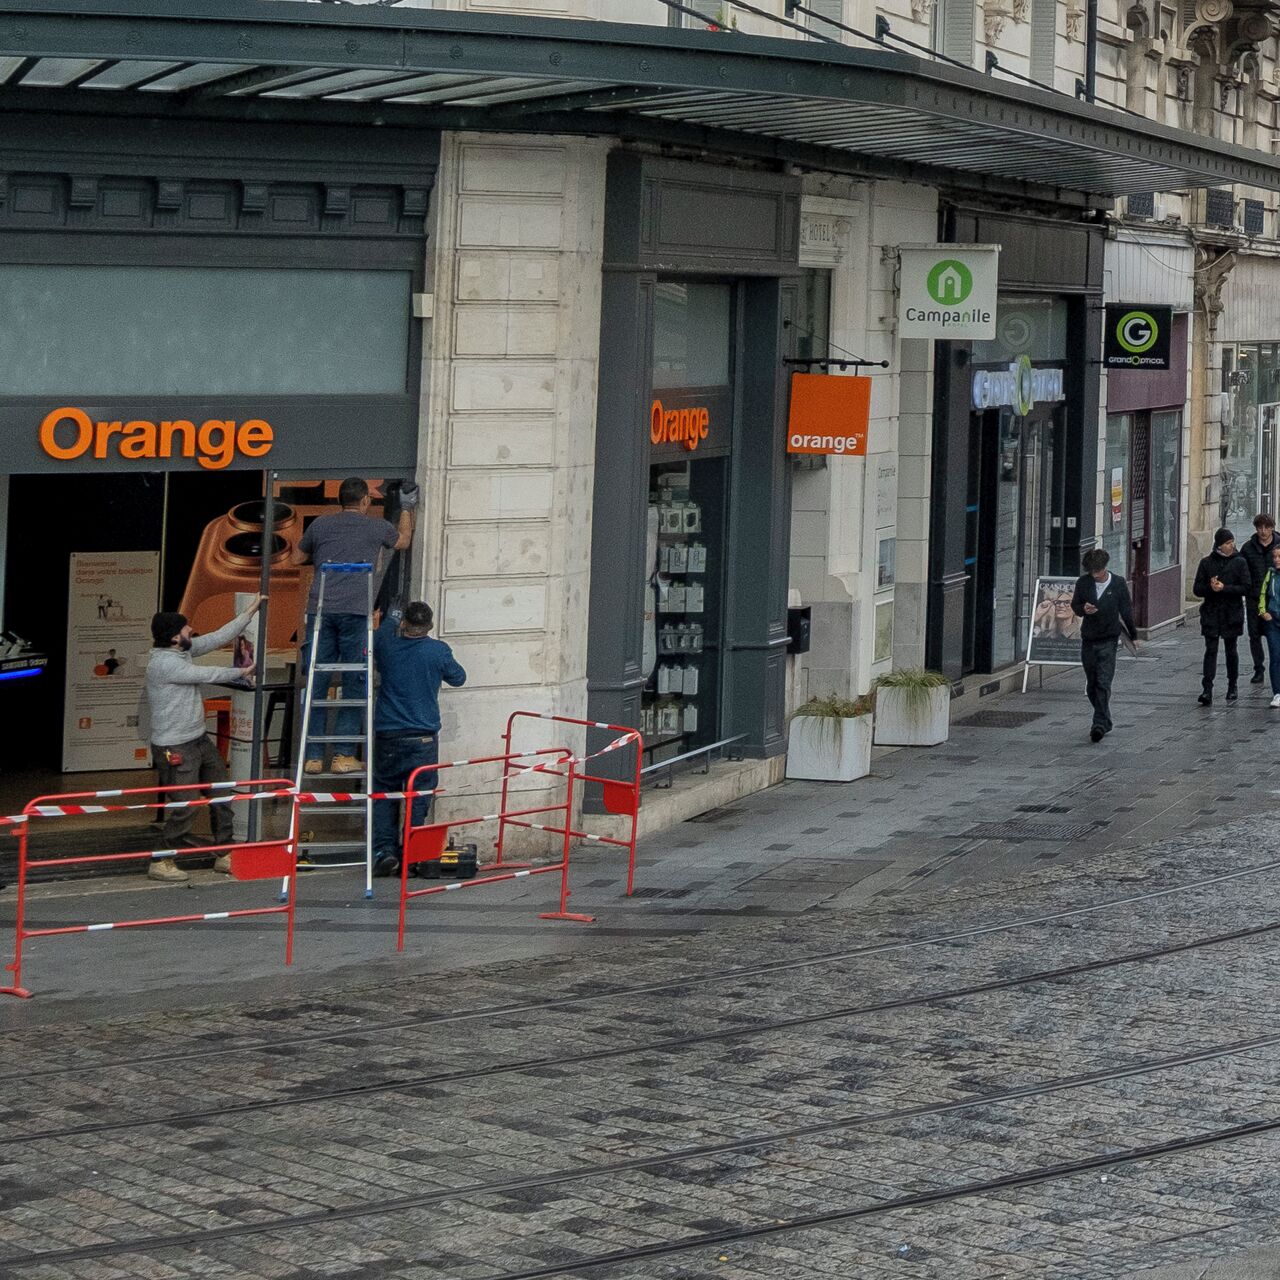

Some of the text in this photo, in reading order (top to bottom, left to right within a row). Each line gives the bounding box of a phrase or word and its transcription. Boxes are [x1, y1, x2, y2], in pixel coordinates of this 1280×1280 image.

[906, 308, 990, 326] Campanile
[39, 406, 274, 470] Orange
[651, 399, 709, 451] Orange
[791, 433, 857, 453] orange
